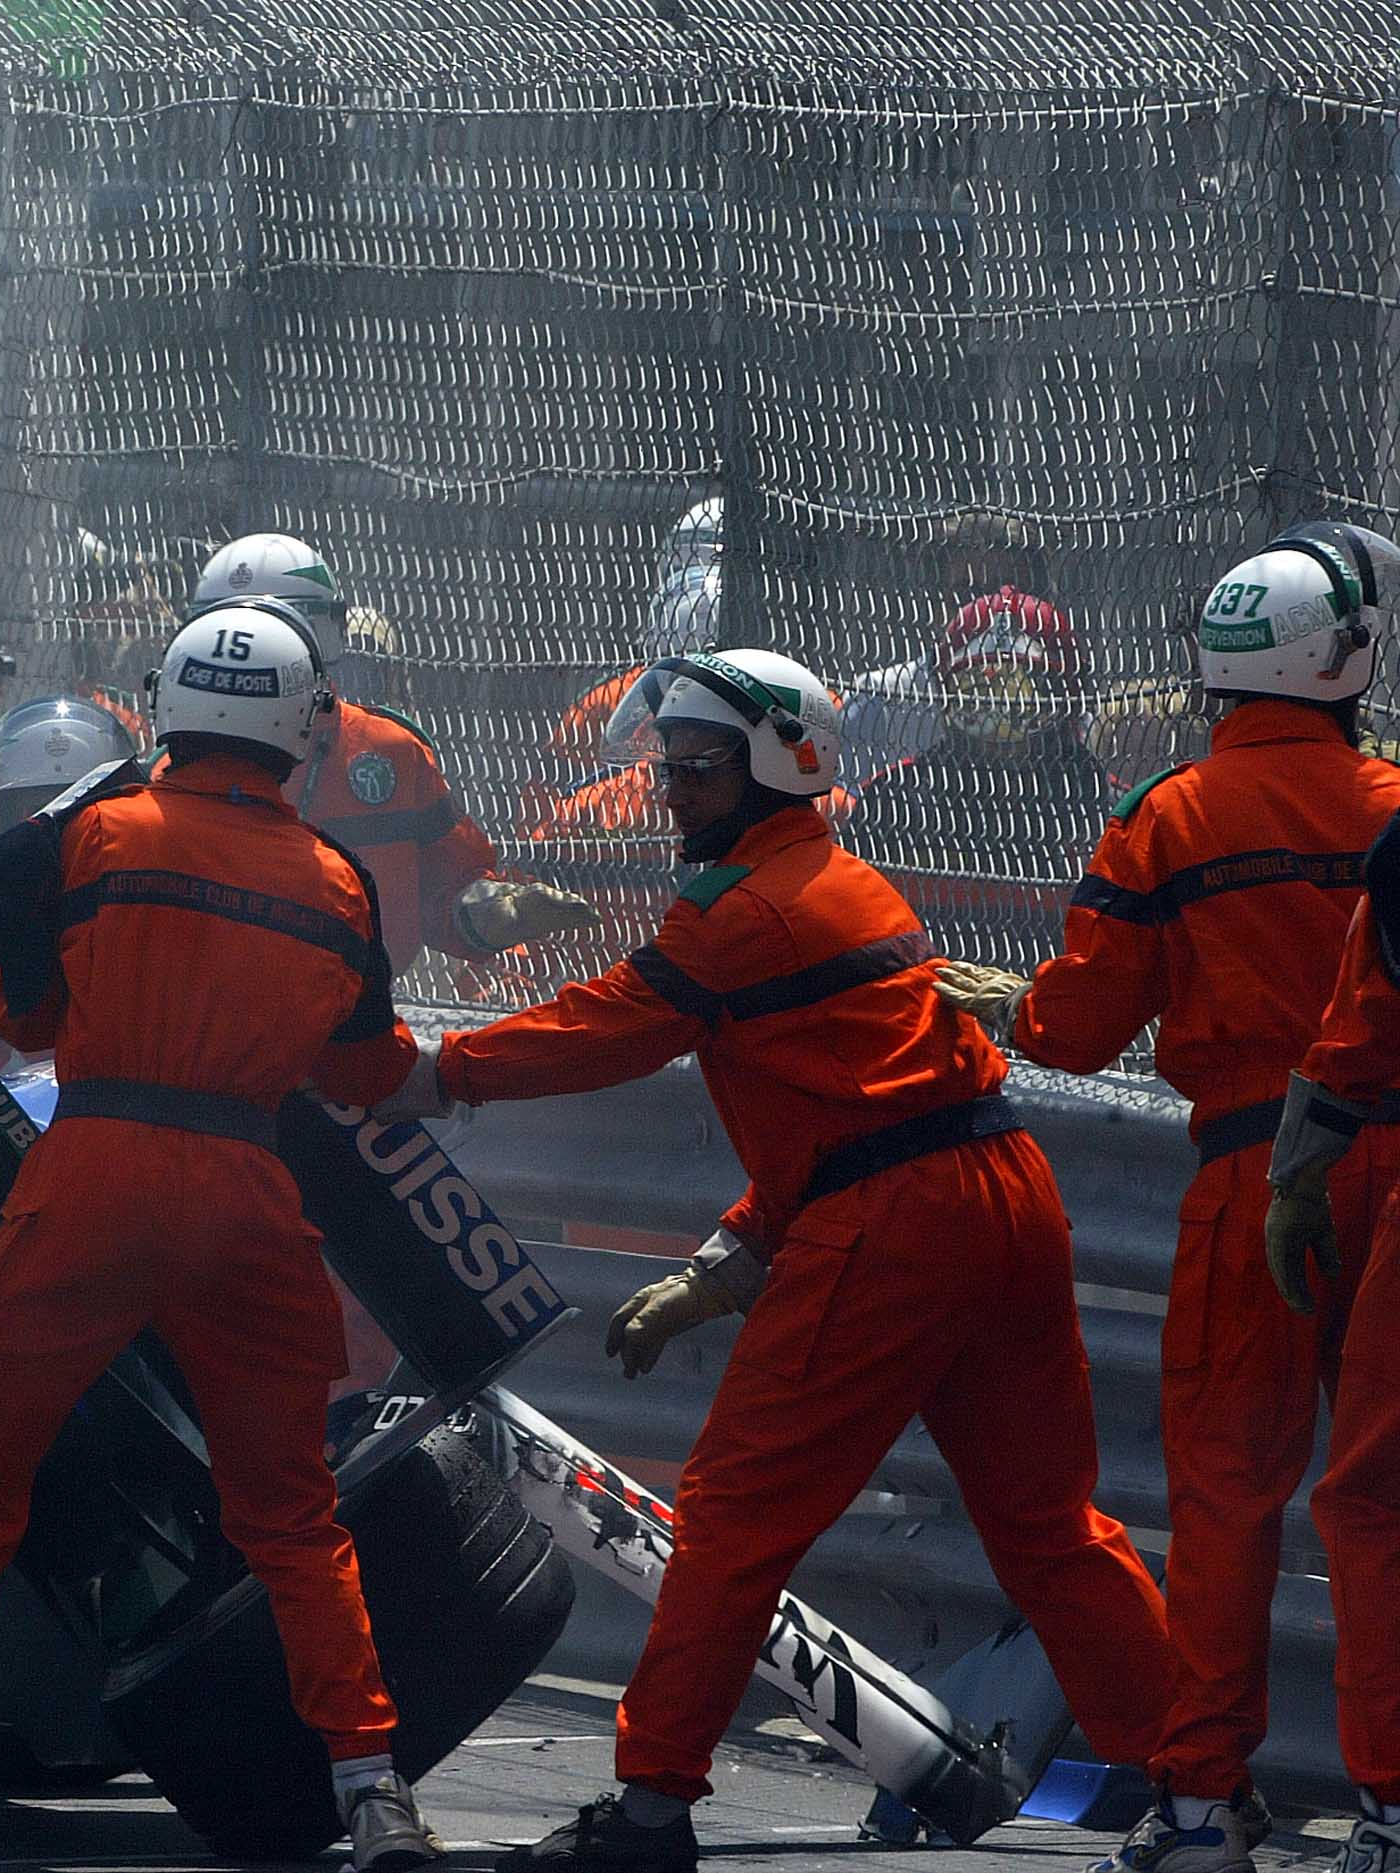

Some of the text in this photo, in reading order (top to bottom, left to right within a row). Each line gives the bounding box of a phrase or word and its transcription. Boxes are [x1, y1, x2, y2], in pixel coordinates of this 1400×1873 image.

[1206, 582, 1270, 617] 337
[1274, 596, 1338, 647] ACM
[211, 629, 255, 662] 15
[215, 672, 232, 689] DE
[234, 674, 273, 692] POSTE
